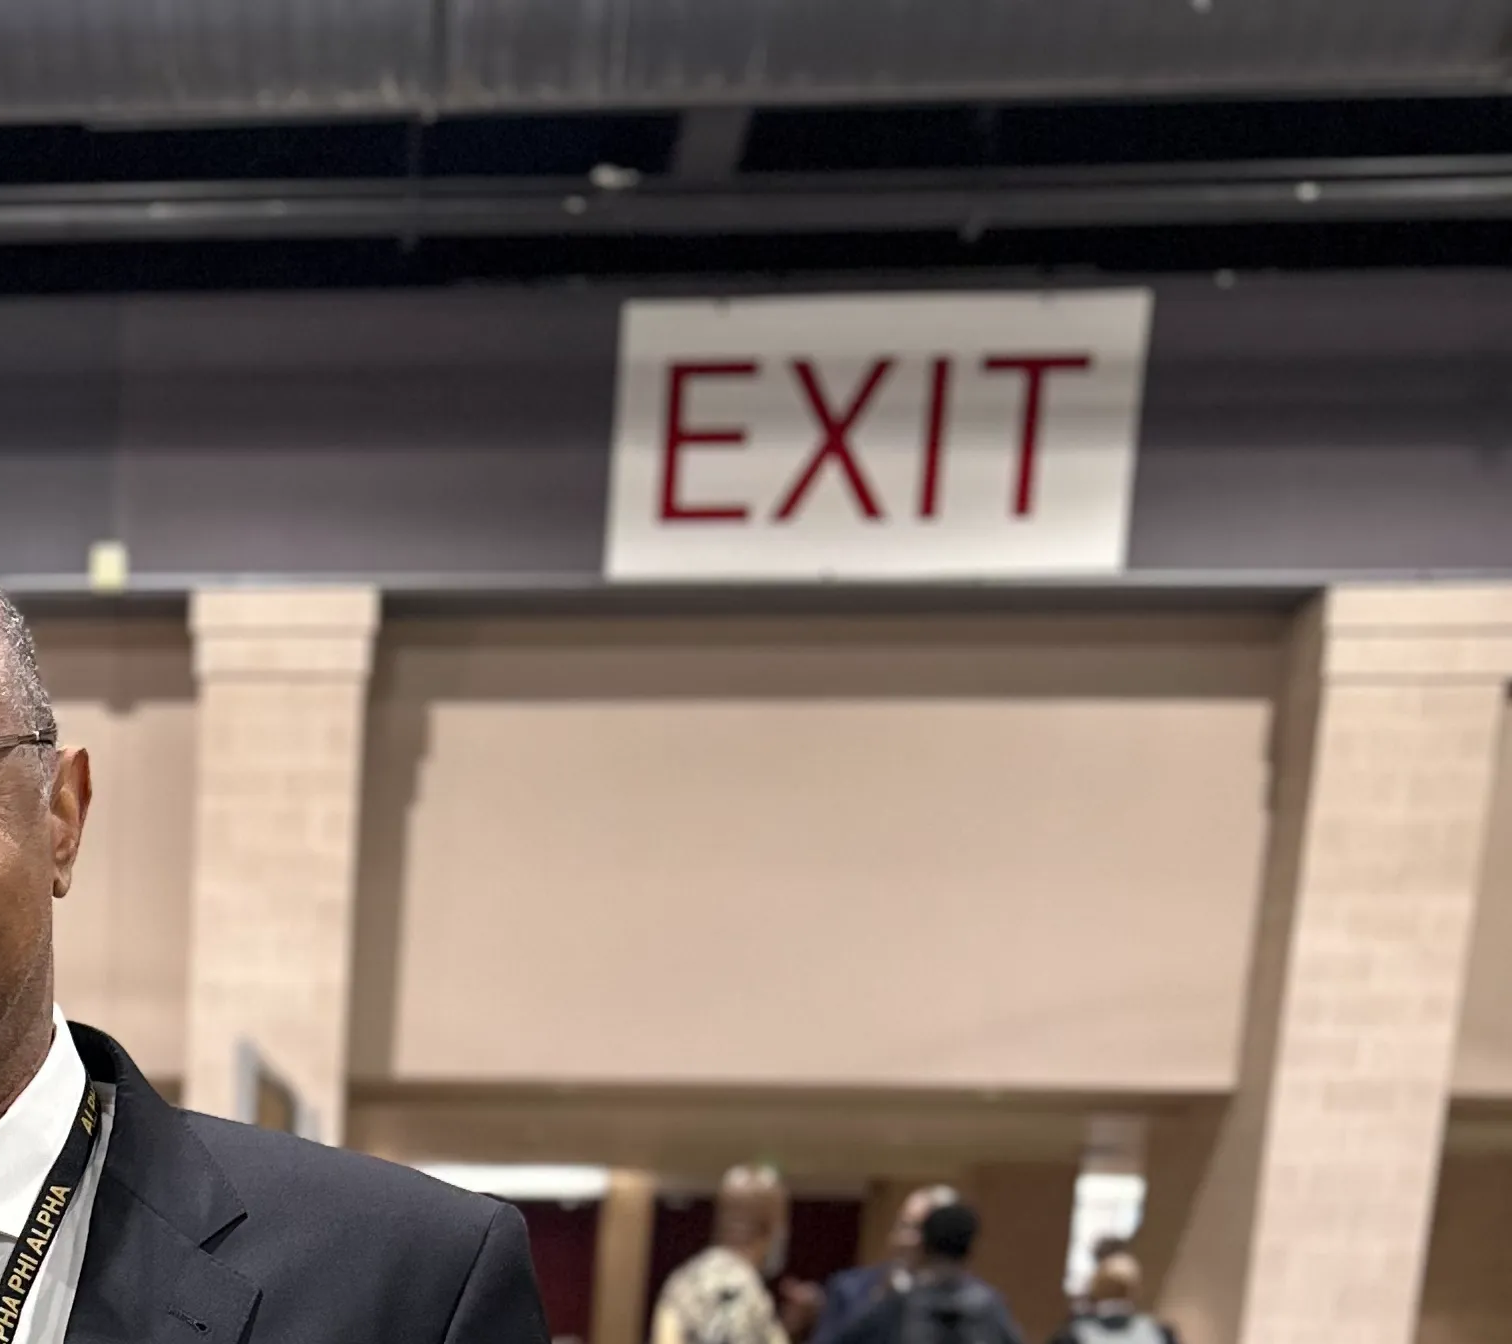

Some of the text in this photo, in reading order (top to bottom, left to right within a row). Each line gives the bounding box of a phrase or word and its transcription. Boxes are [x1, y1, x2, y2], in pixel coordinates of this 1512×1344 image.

[658, 357, 1091, 521] EXIT
[81, 1089, 97, 1136] ALP
[8, 1252, 39, 1296] PHI
[27, 1185, 72, 1257] ALPHA
